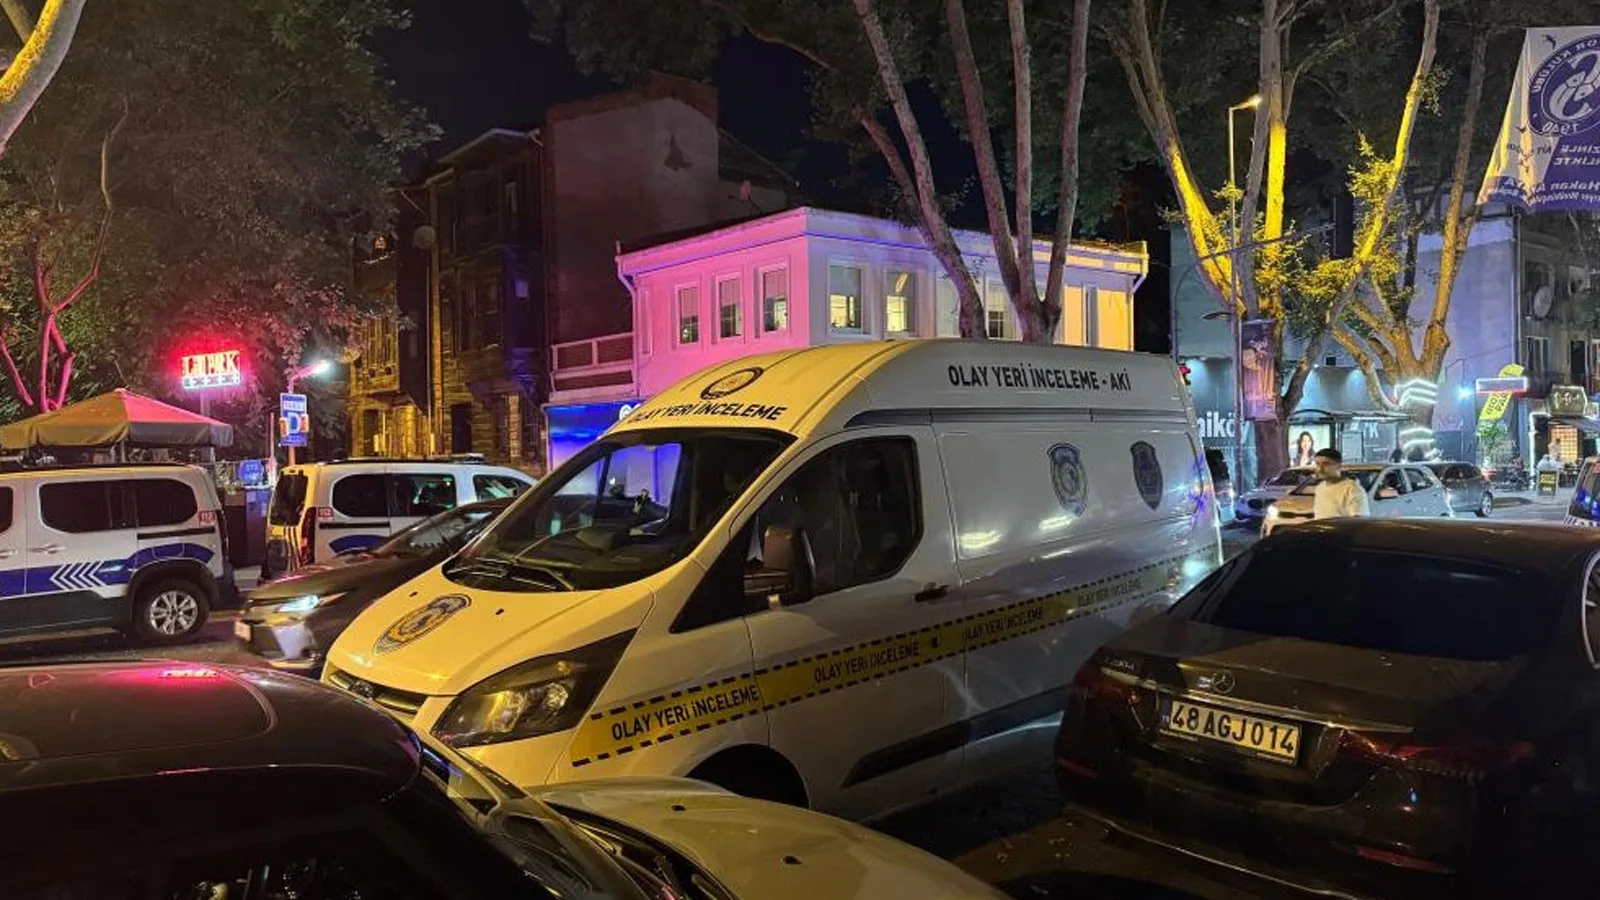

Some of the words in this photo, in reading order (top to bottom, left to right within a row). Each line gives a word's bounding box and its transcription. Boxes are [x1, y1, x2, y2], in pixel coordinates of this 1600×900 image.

[948, 364, 988, 387] OLAY
[992, 363, 1028, 387] YERİ
[1029, 364, 1100, 389] İNCELEME
[1110, 367, 1131, 391] AKİ
[693, 401, 788, 421] İNCELEME
[612, 716, 652, 741] OLAY
[814, 663, 842, 684] OLAY
[1172, 704, 1199, 731] 48
[1204, 710, 1247, 742] AGJ
[1250, 721, 1294, 754] 014
